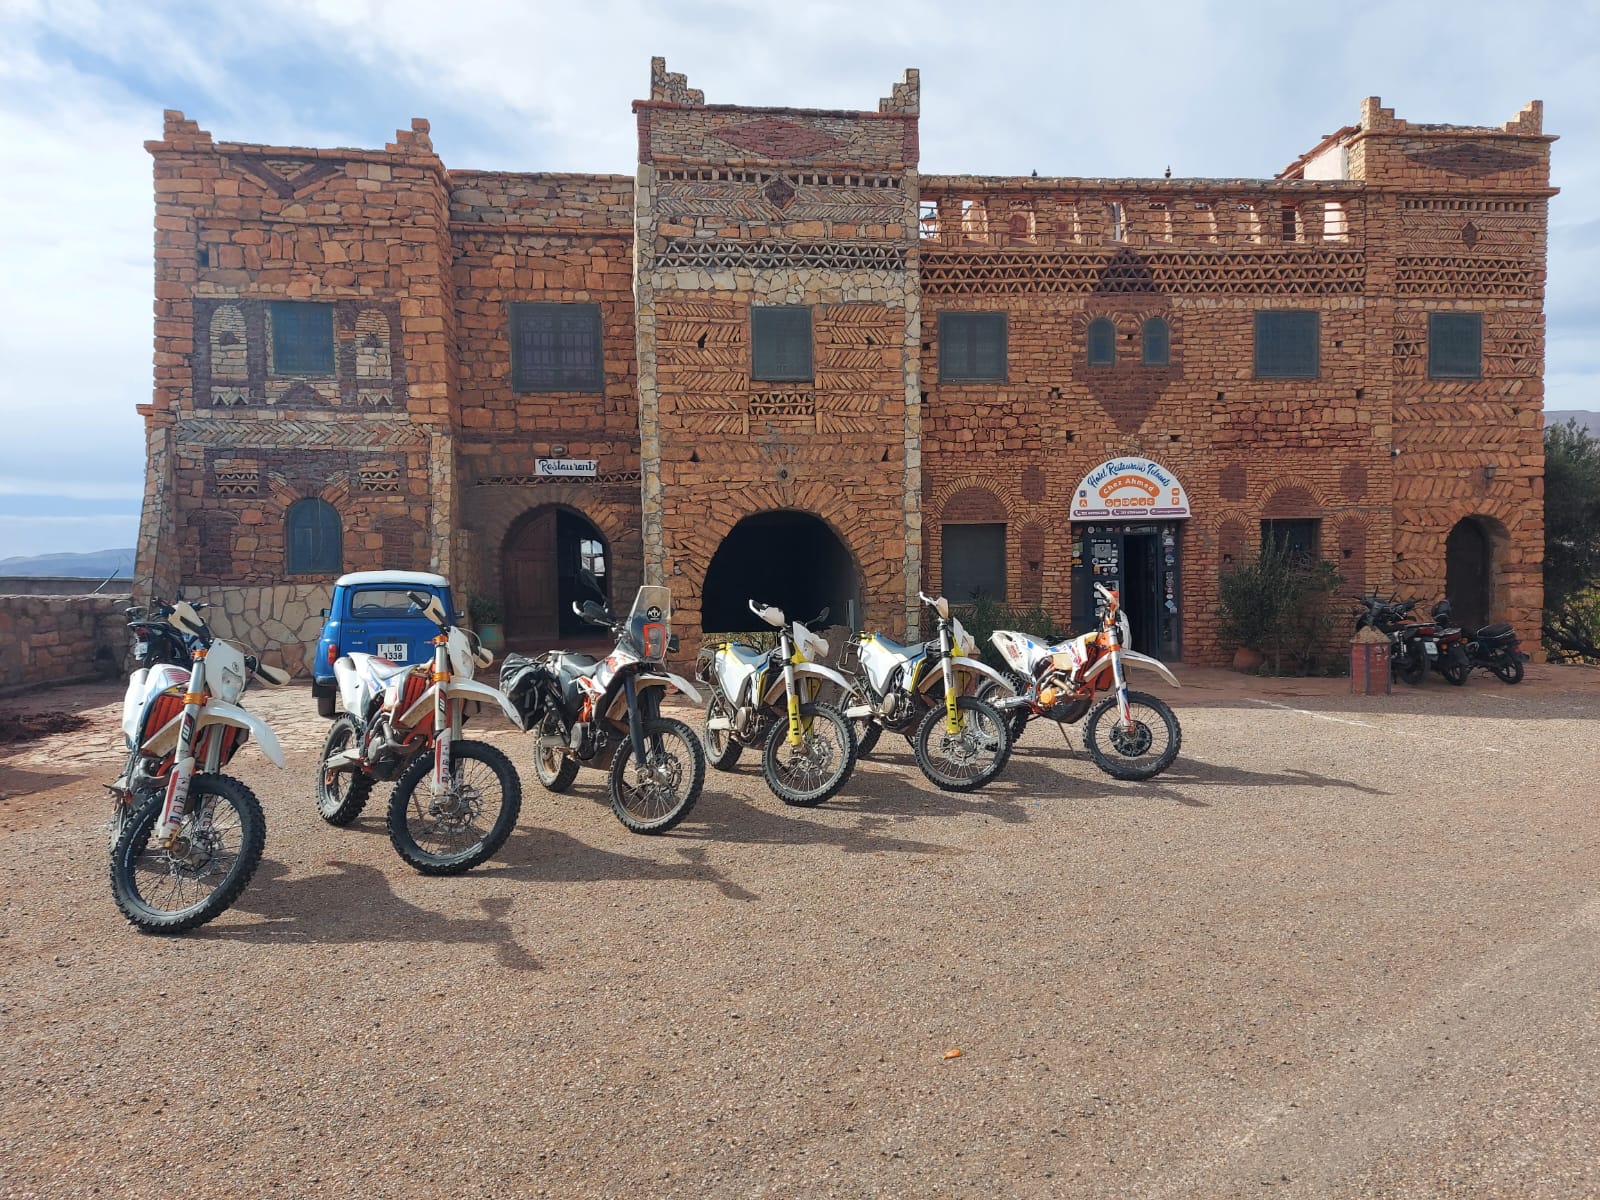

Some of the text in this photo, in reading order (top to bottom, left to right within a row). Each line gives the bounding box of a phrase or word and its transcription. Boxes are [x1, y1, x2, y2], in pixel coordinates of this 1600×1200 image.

[538, 459, 596, 474] Restaurant
[1087, 468, 1106, 488] Hotel
[1147, 463, 1170, 486] Telouet
[1103, 478, 1155, 494] Chez Ahmed
